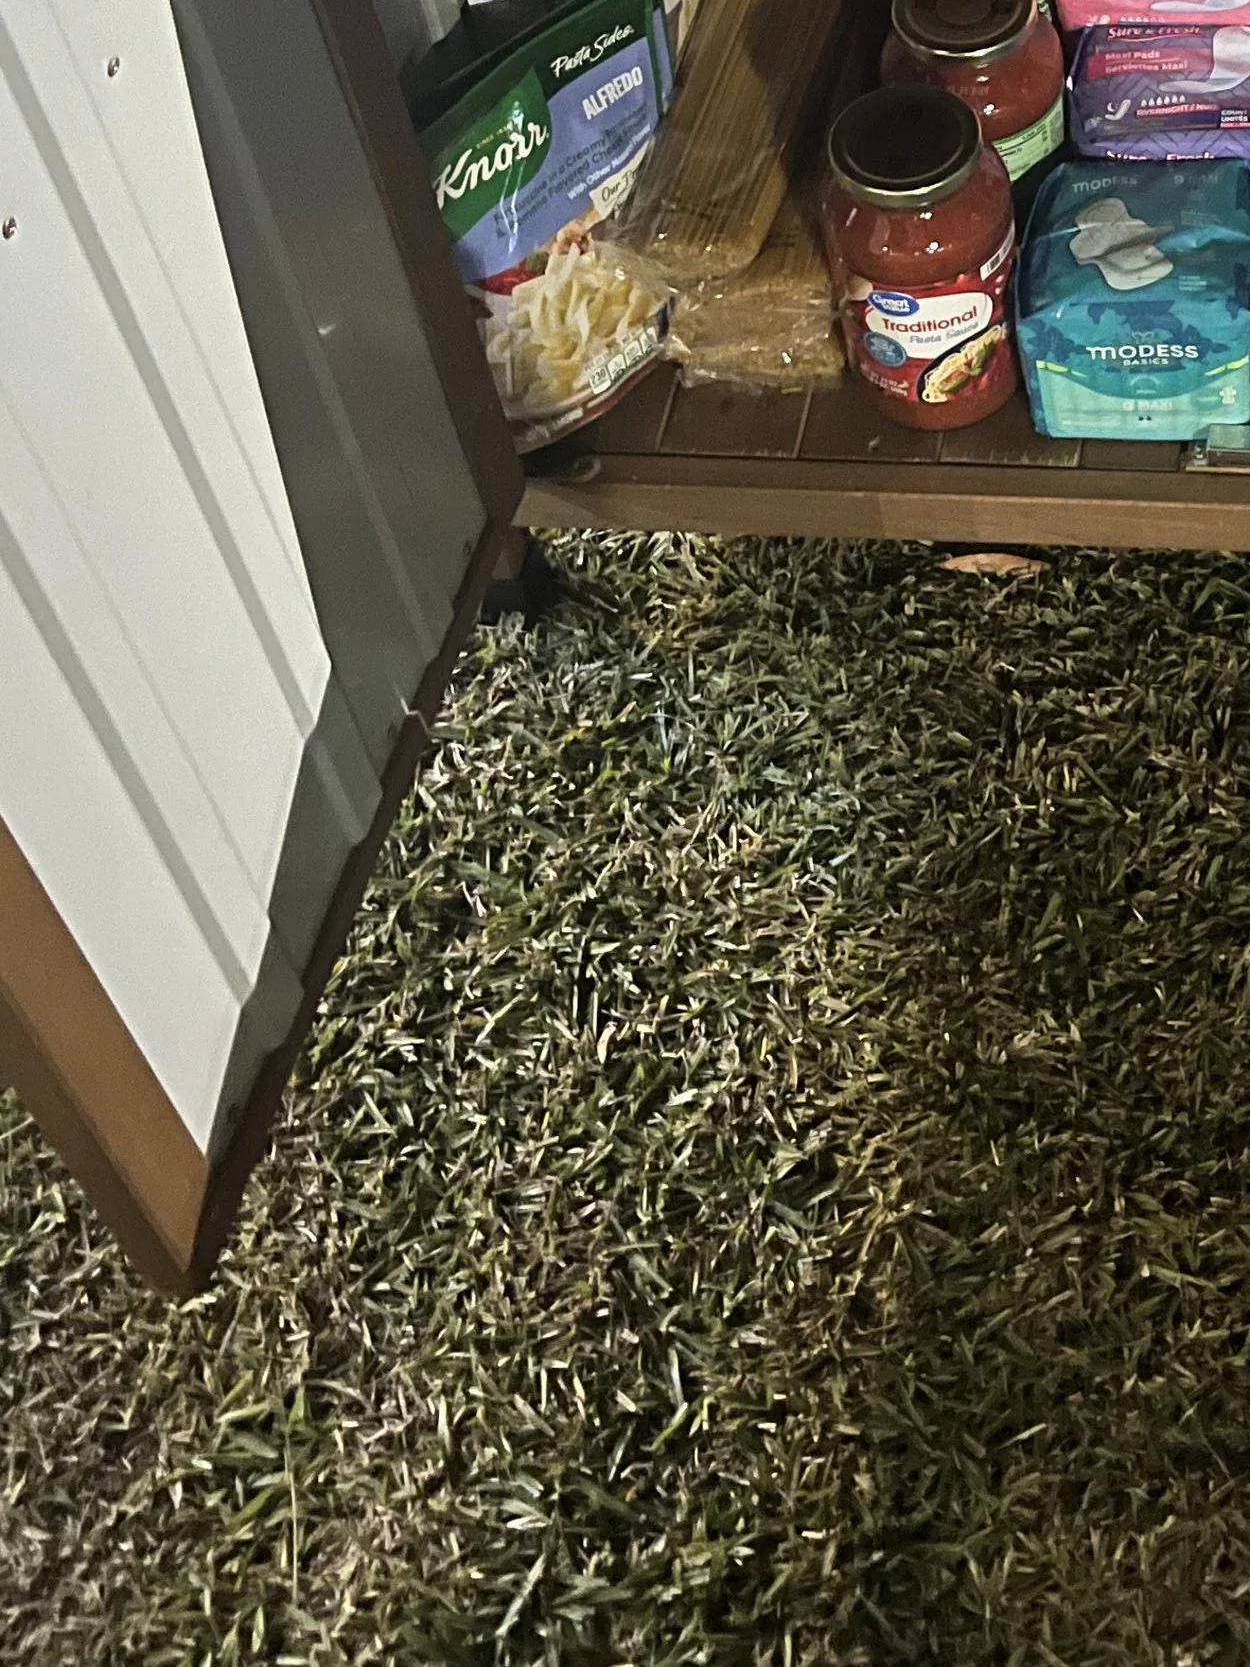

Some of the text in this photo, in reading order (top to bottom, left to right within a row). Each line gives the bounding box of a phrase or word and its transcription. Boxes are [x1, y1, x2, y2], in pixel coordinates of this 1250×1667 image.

[550, 24, 635, 78] Pasta Sides
[1105, 50, 1161, 61] Maxi Pads
[1161, 61, 1188, 72] Maxi
[581, 66, 644, 121] ALFREDO
[1136, 103, 1190, 117] OVERNIGHT
[432, 121, 547, 211] Knorr
[600, 179, 620, 203] Our
[881, 305, 979, 334] Traditional
[1122, 357, 1169, 367] BASICS
